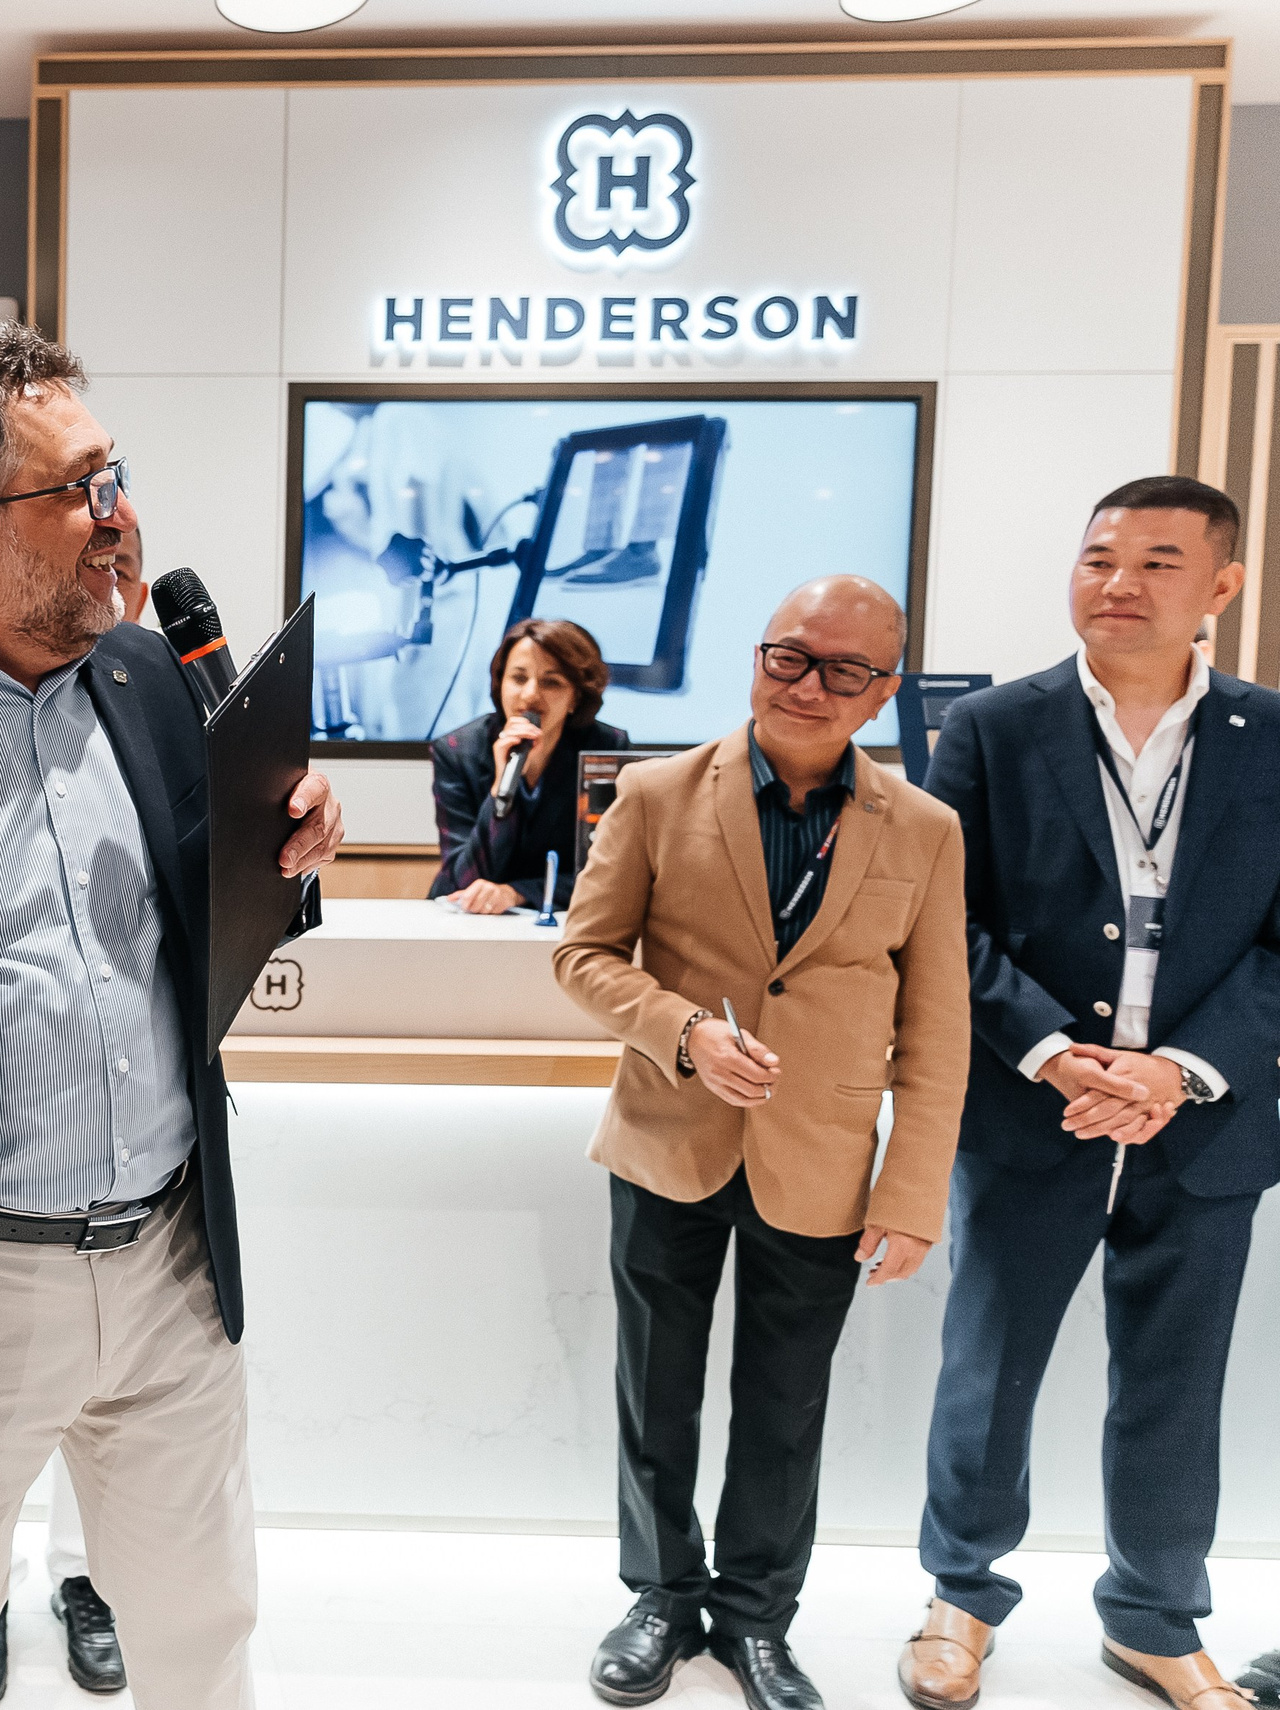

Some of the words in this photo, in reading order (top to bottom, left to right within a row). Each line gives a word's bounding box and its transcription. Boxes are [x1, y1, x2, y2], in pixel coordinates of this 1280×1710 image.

[597, 156, 651, 210] H
[385, 295, 858, 341] HENDERSON
[266, 974, 286, 995] H
